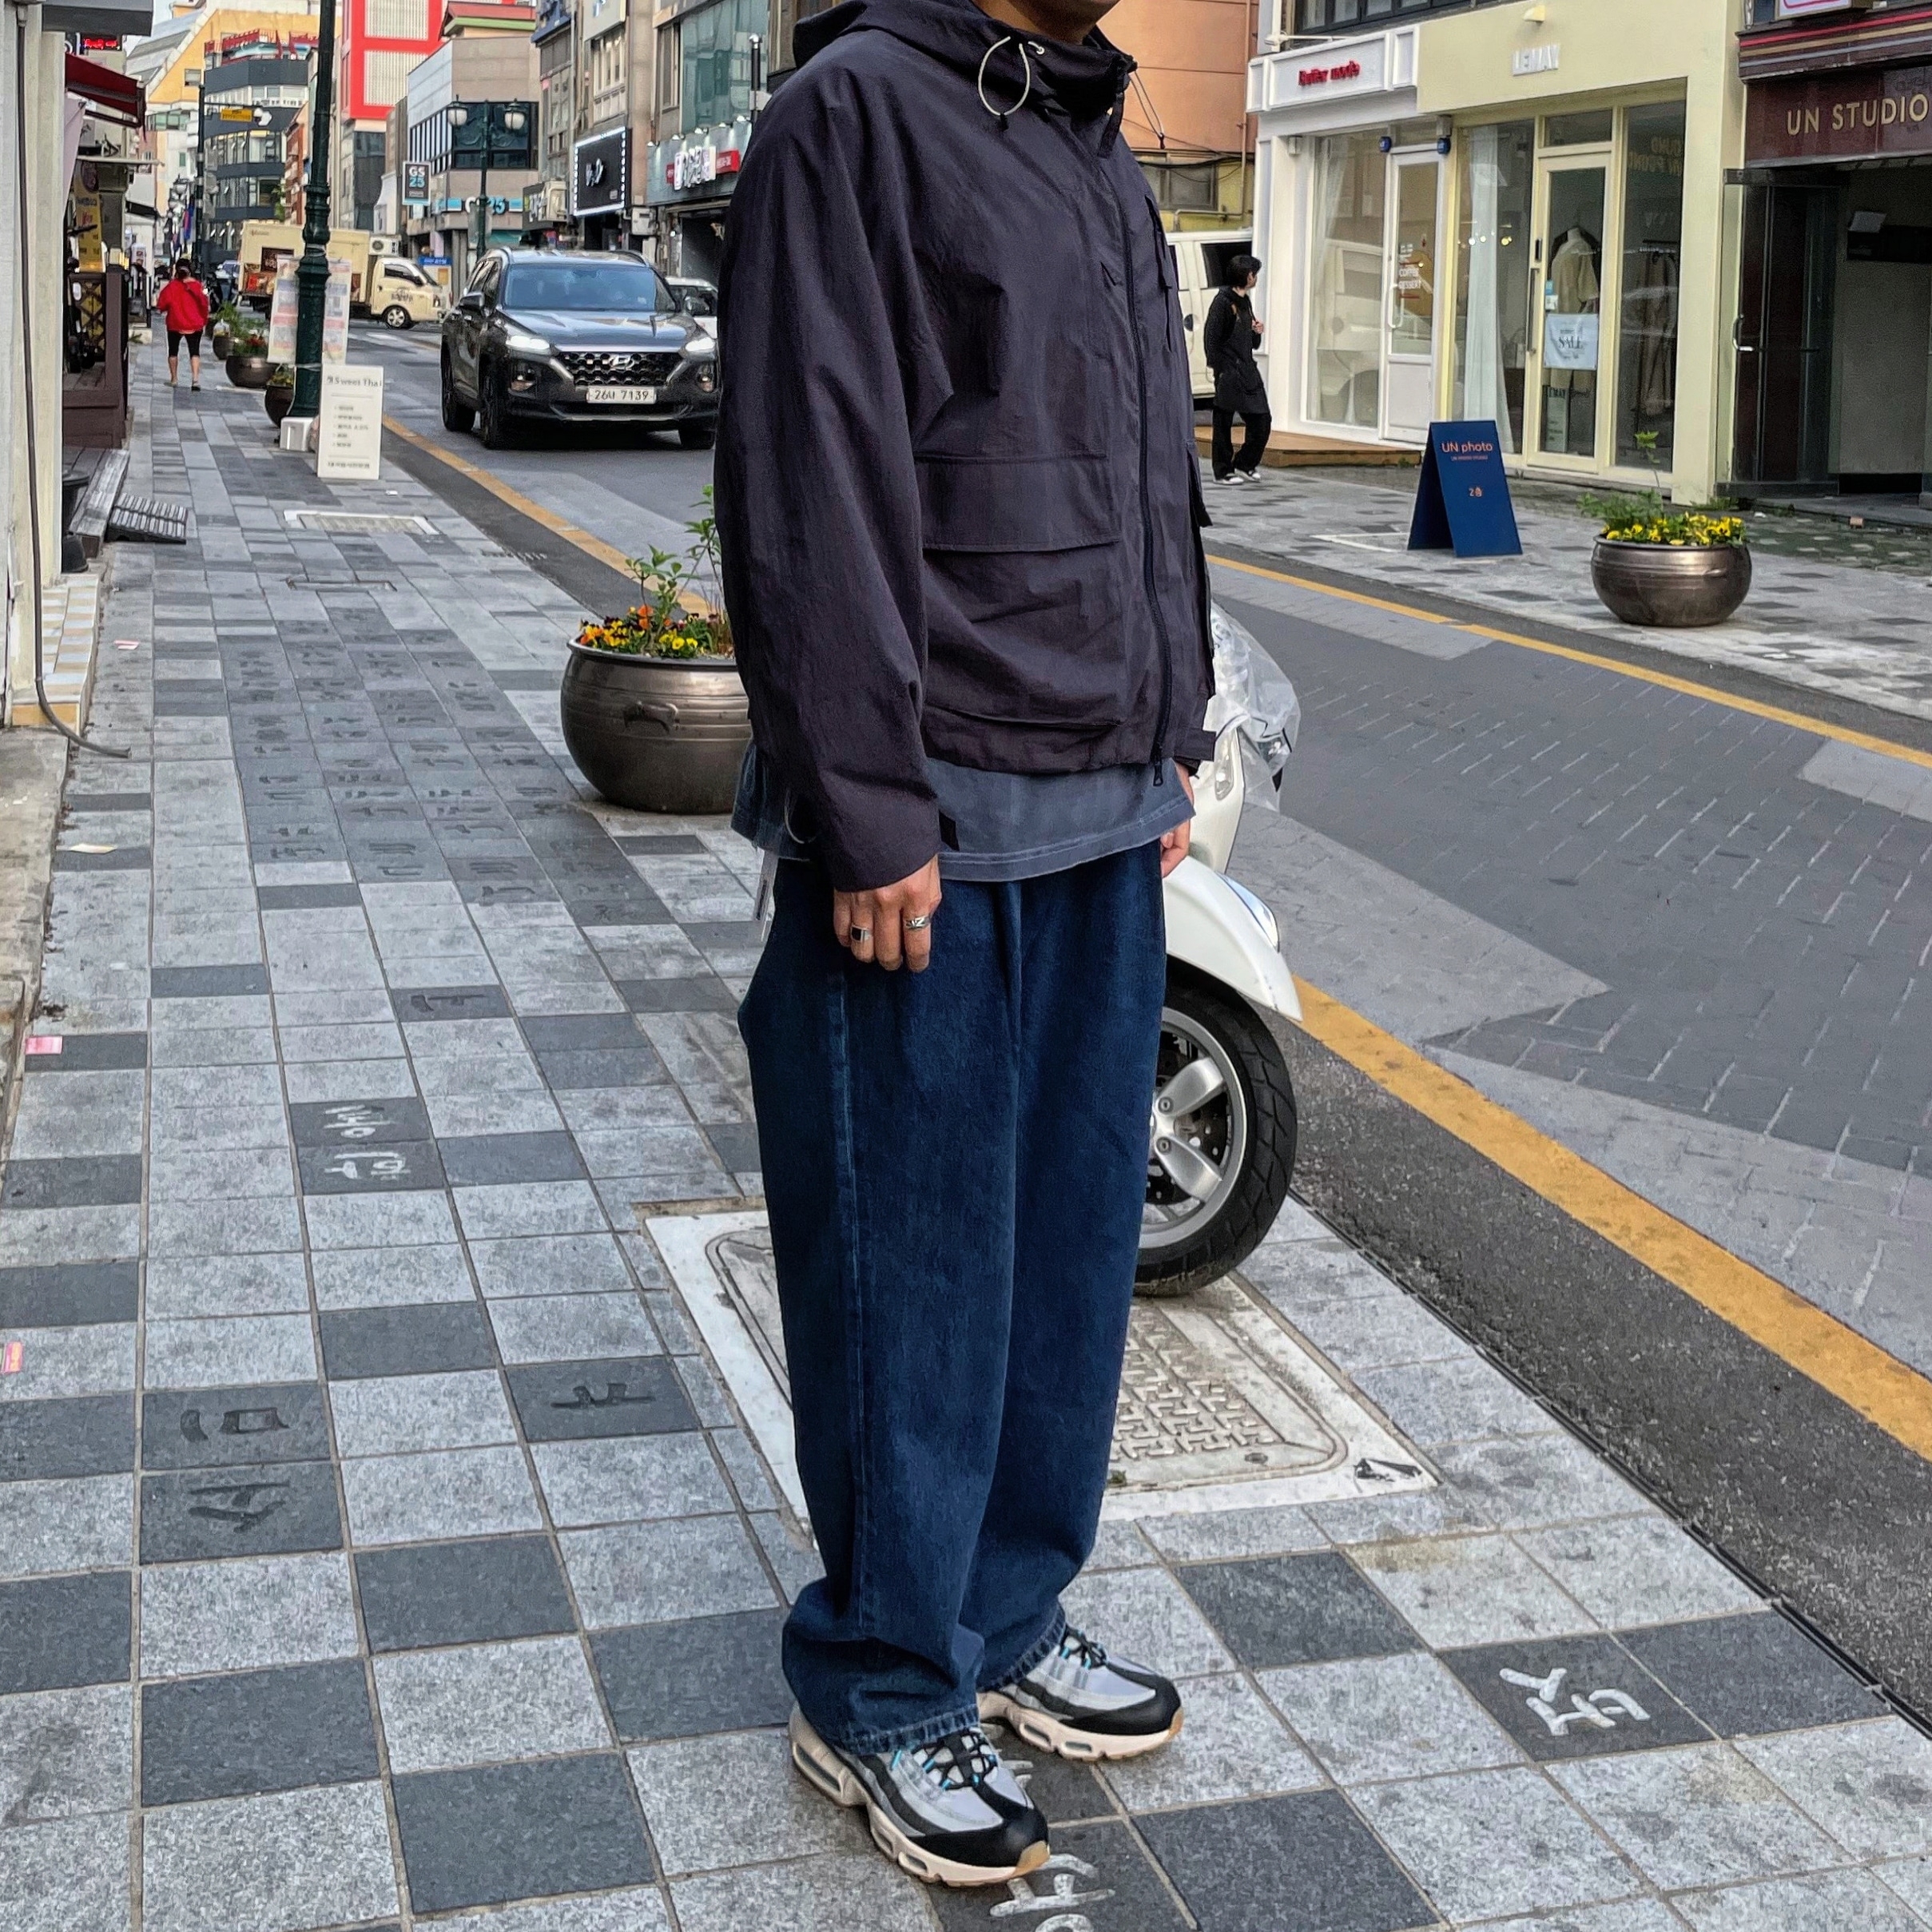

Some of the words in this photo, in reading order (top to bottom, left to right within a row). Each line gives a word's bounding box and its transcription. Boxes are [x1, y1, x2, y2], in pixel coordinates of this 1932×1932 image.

[1787, 107, 1819, 136] UN
[1832, 93, 1929, 131] STUDIO
[408, 165, 425, 177] GS
[409, 177, 426, 188] 25
[1441, 441, 1459, 453] UN
[1461, 441, 1493, 454] photo
